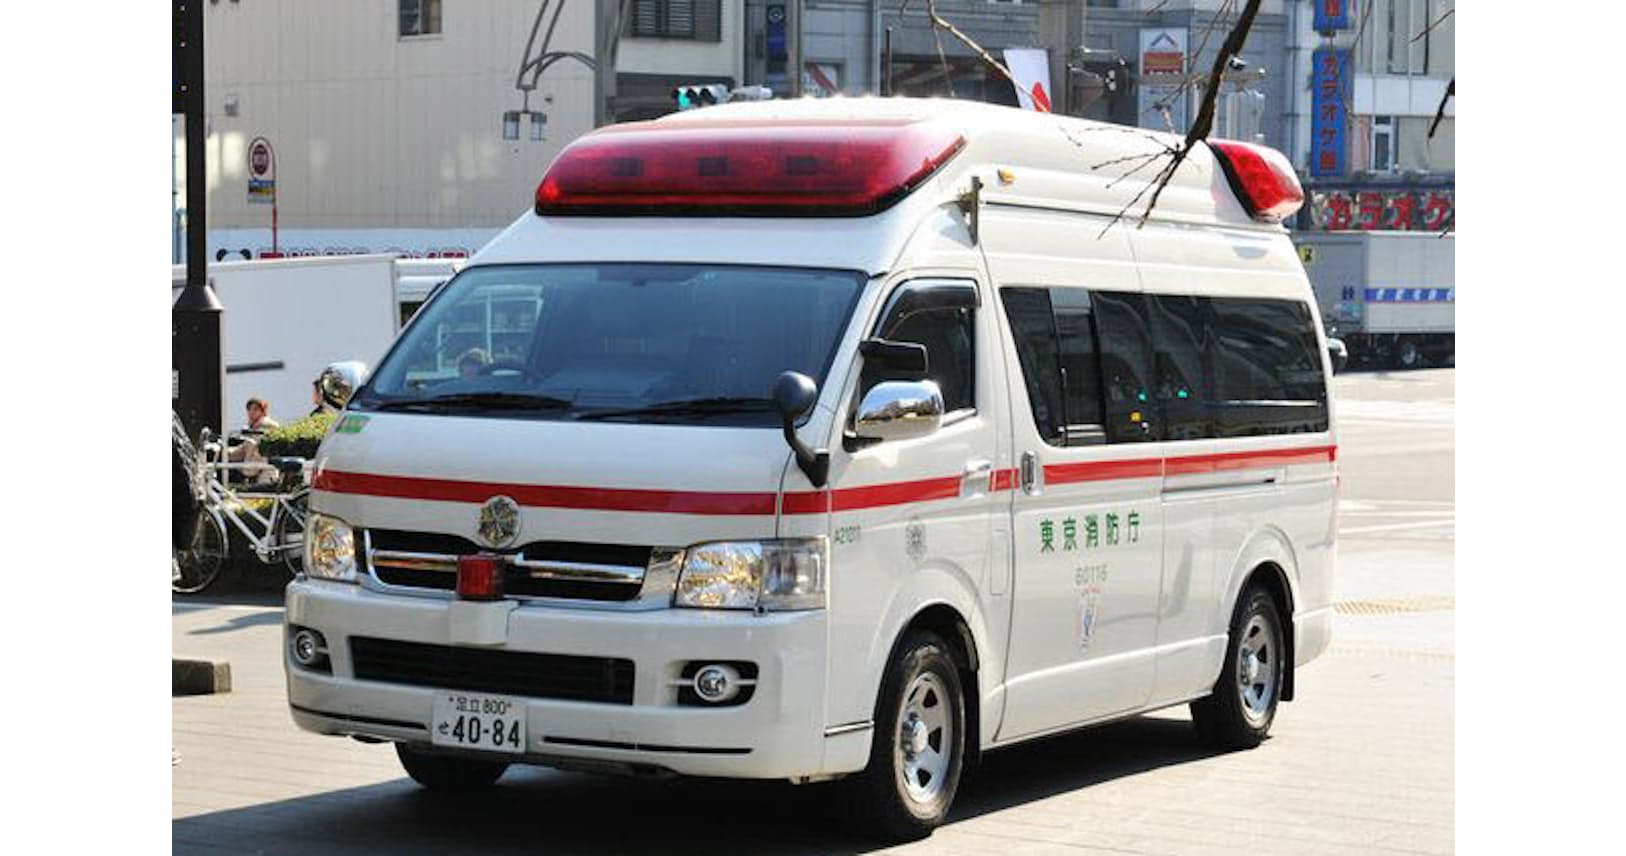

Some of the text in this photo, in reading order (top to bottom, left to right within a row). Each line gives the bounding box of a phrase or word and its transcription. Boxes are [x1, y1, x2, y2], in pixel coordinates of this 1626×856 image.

[1327, 191, 1455, 231] カラオケ
[1040, 509, 1139, 552] 東京消防庁
[452, 715, 519, 748] 40-84
